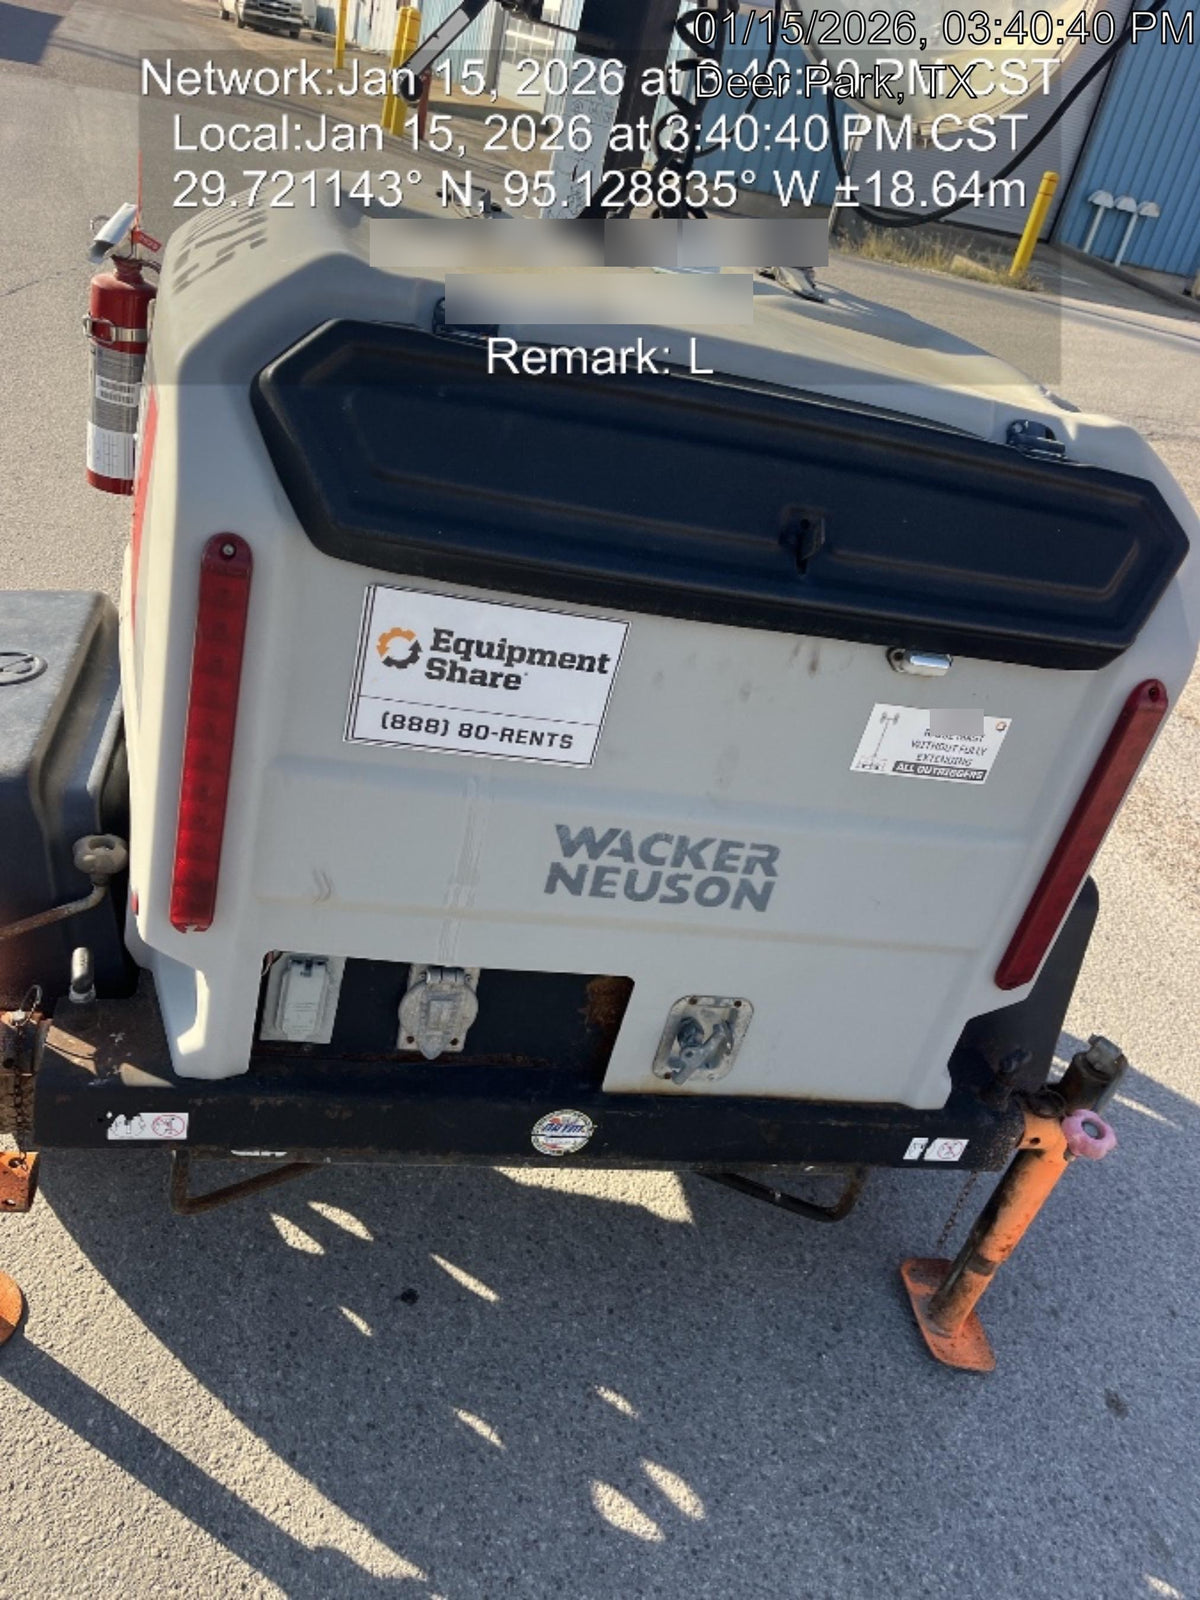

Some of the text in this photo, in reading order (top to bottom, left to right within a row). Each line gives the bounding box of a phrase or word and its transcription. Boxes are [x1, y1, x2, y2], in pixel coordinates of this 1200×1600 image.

[424, 656, 523, 691] Share
[430, 627, 611, 674] Equipment
[380, 711, 575, 749] (888) 80-RENTS
[555, 823, 782, 877] WACKER
[543, 861, 776, 913] NEUSON
